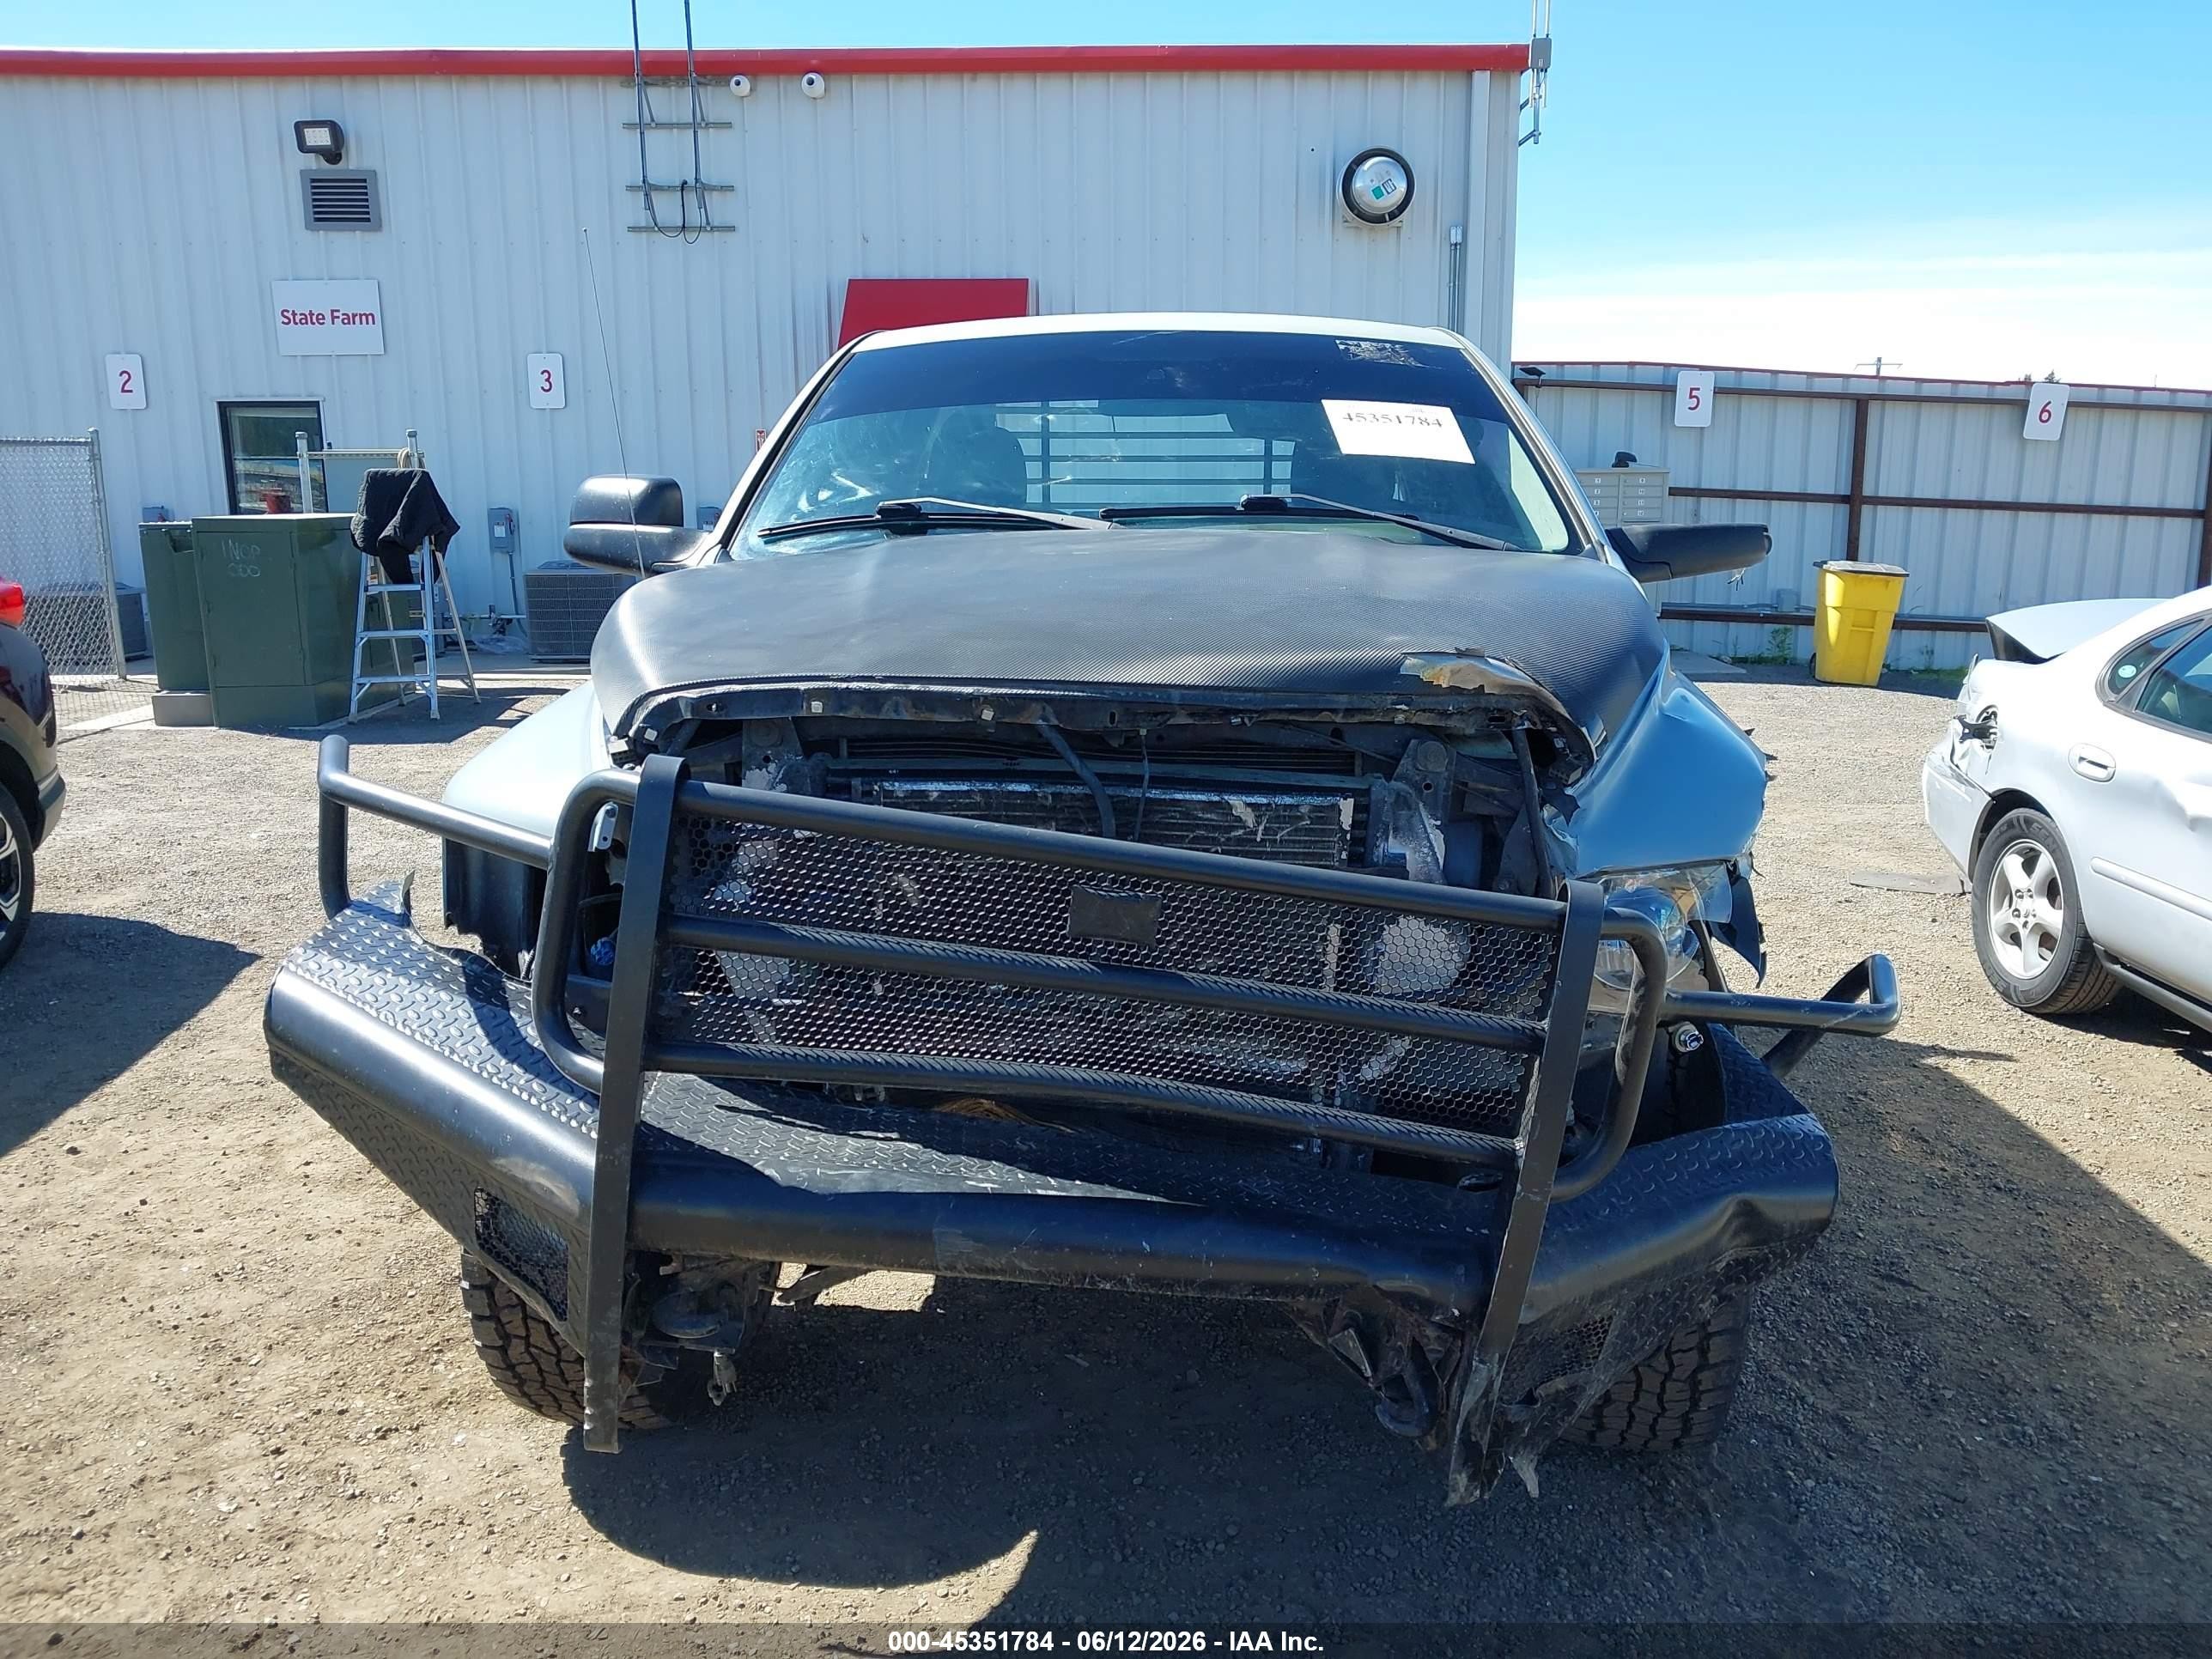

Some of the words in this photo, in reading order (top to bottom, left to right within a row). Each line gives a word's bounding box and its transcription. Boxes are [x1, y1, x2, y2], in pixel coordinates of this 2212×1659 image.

[280, 308, 325, 325] State
[330, 308, 376, 325] Farm
[118, 370, 133, 393] 2
[540, 369, 552, 392] 3
[1687, 387, 1700, 410] 5
[1342, 412, 1443, 428] 45351784
[2039, 400, 2051, 423] 6
